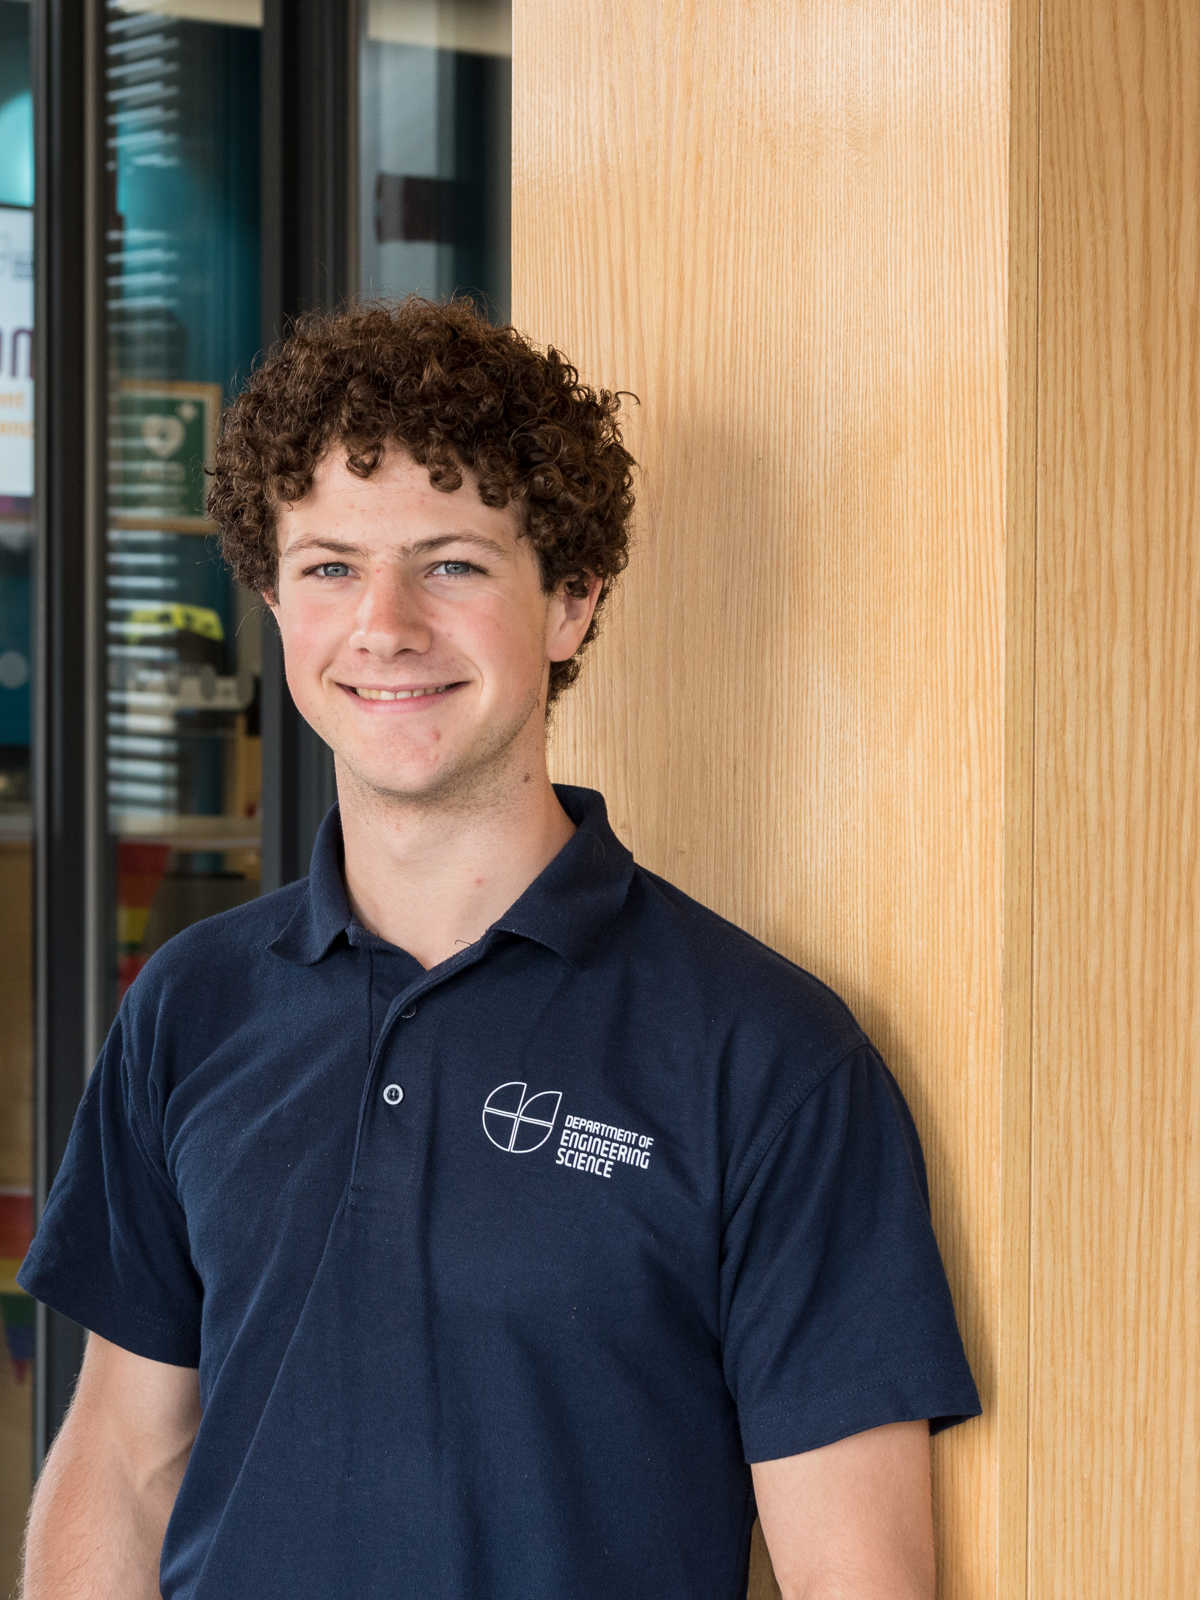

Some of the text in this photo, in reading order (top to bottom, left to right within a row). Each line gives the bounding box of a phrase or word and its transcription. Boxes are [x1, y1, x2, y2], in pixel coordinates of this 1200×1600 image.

[559, 1129, 651, 1170] ENGINEERING
[564, 1114, 655, 1150] DEPARTMENT OF
[555, 1148, 615, 1179] SCIENCE
